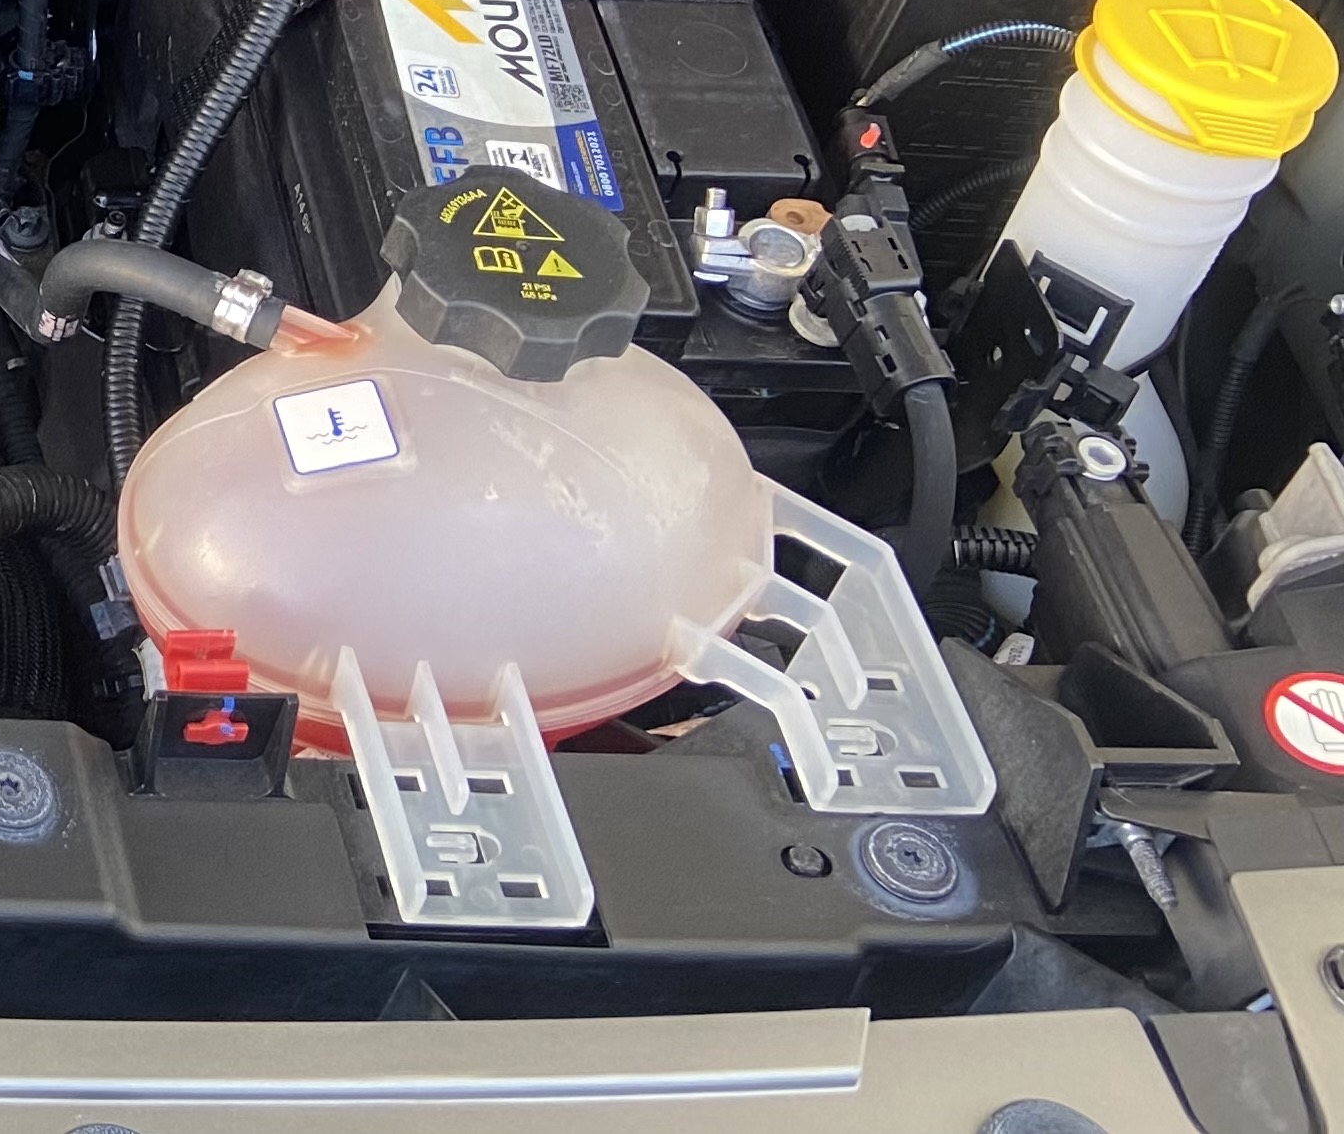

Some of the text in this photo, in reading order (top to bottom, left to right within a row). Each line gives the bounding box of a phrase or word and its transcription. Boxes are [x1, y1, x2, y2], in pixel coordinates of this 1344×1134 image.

[413, 69, 438, 95] 24
[595, 168, 614, 197] 0800
[521, 282, 551, 292] 21 PSI
